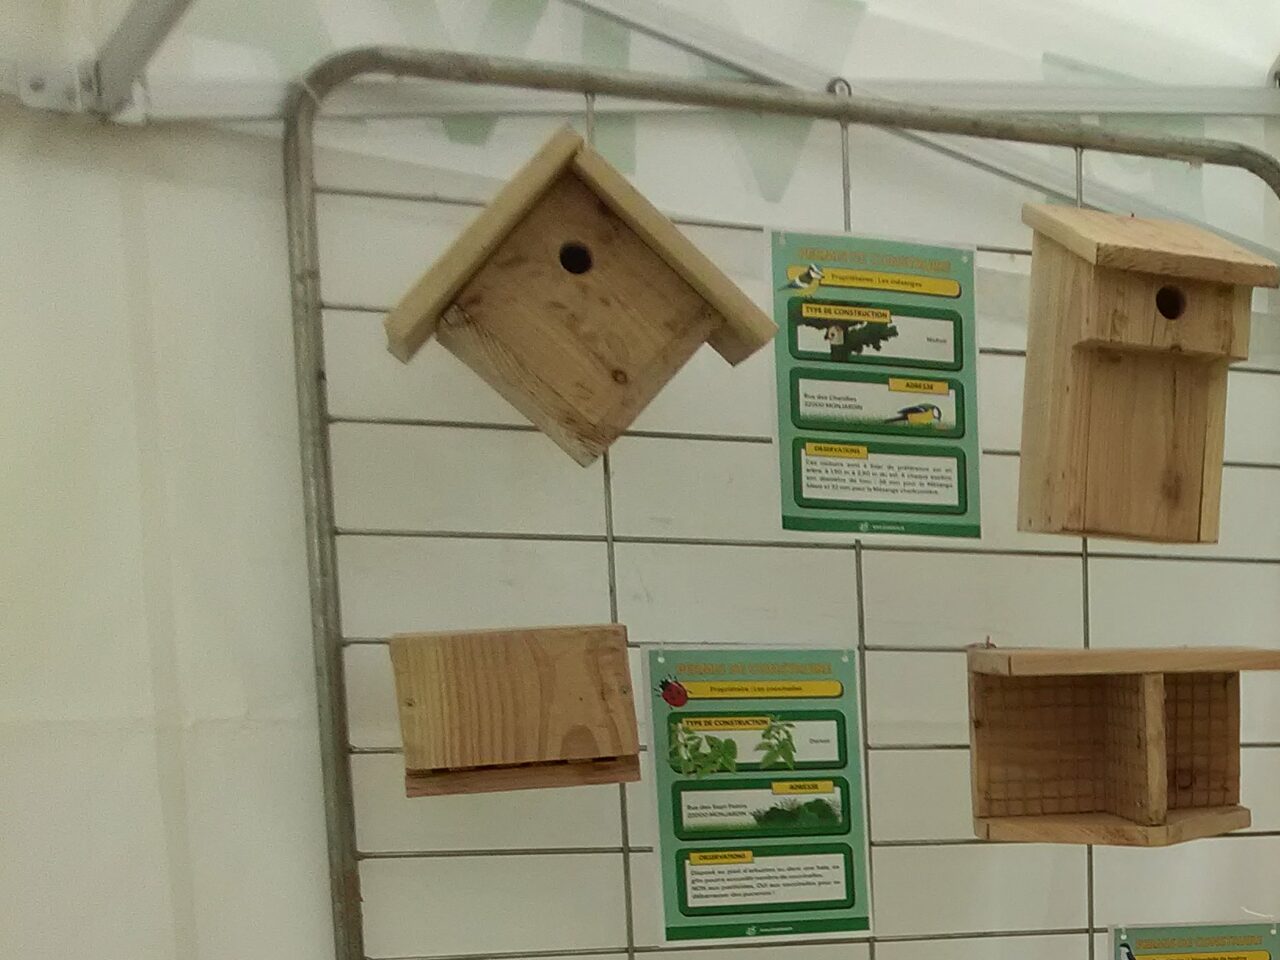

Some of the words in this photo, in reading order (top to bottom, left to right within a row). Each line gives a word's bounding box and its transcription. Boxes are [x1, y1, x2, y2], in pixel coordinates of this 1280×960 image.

[805, 305, 822, 314] TYPE
[823, 306, 832, 315] DE
[833, 307, 887, 319] CONSTRUCTION
[684, 719, 703, 727] TYPE
[713, 718, 769, 726] CONSTRUCTION
